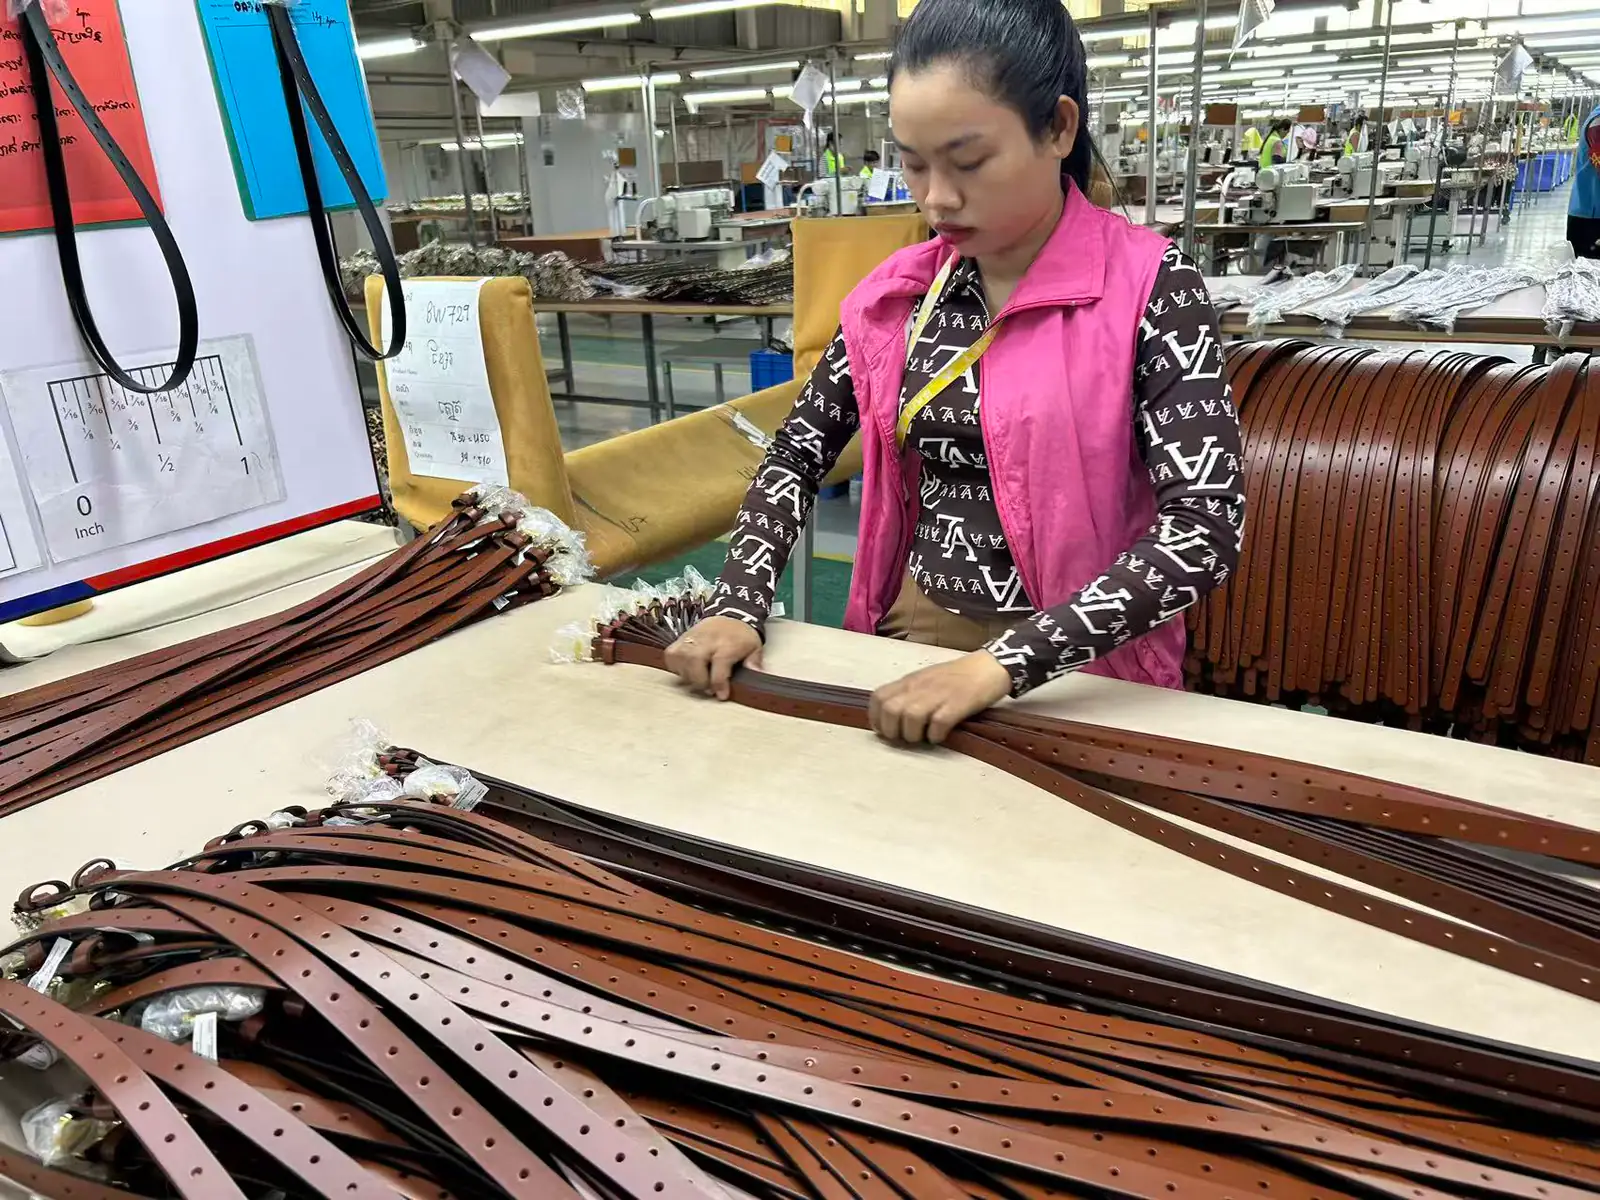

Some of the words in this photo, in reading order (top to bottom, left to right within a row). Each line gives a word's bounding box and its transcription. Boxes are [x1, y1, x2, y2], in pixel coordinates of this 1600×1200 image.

[62, 407, 78, 419] 1/16
[158, 454, 175, 472] 1/2
[241, 456, 249, 474] 1
[77, 495, 92, 516] 0
[75, 522, 105, 539] Inch
